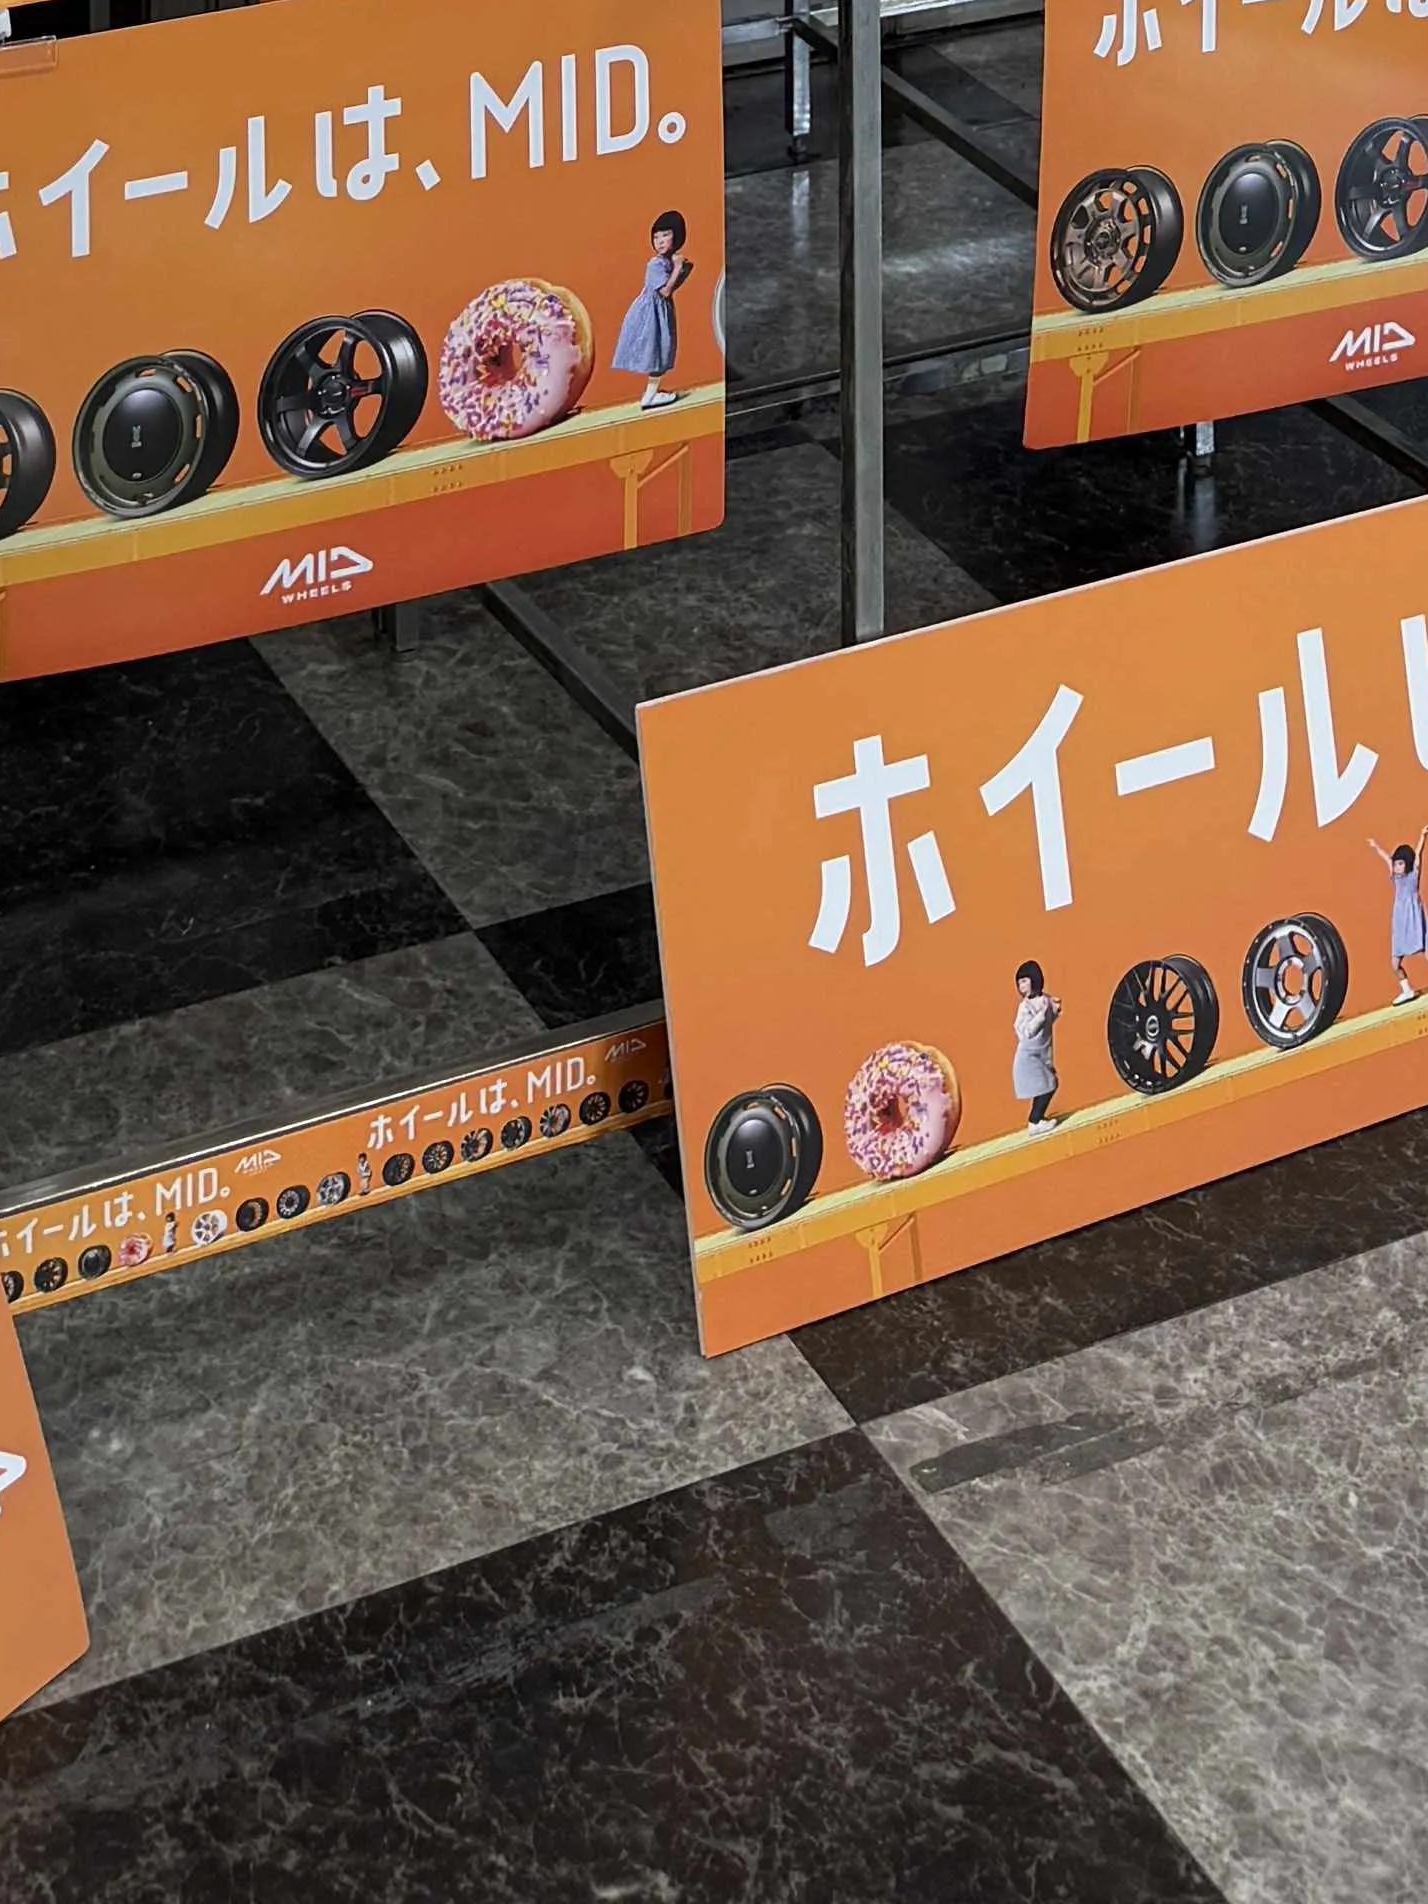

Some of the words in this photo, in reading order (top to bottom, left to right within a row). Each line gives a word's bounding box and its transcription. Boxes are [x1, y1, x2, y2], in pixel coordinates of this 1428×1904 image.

[1329, 321, 1416, 363] MID
[1344, 352, 1400, 372] WHEELS
[259, 545, 373, 595] MID
[281, 580, 352, 605] WHEELS
[367, 1055, 597, 1152] ホイールは、MID。
